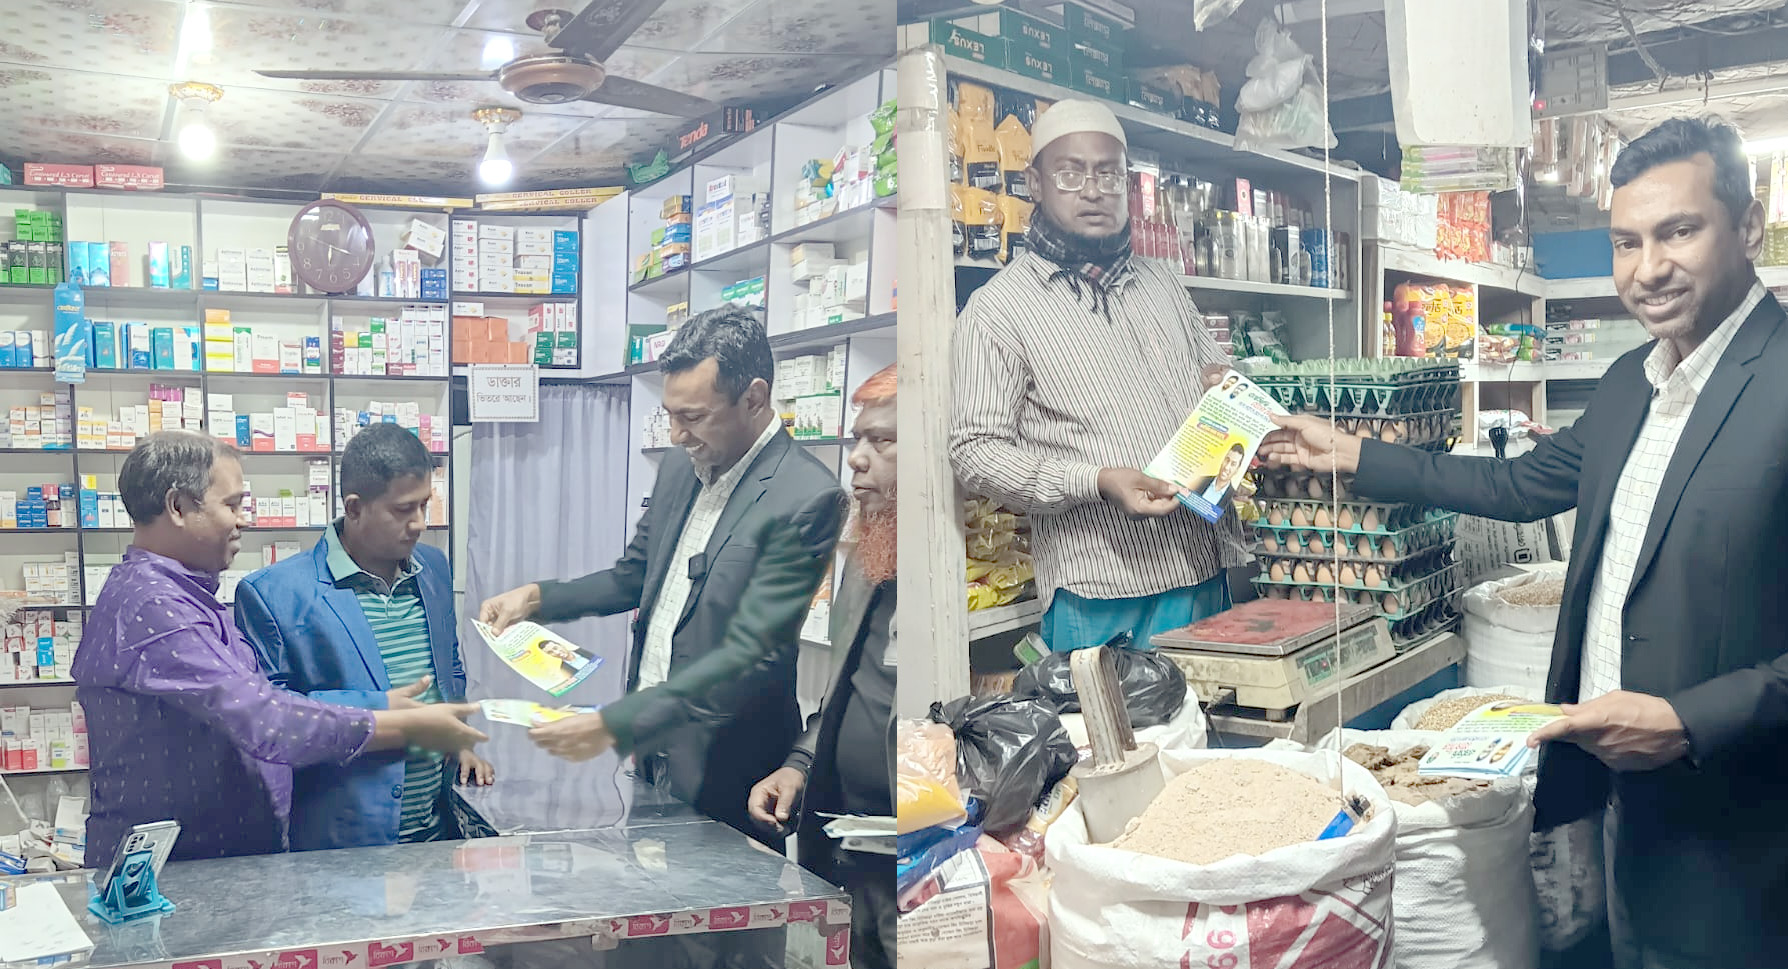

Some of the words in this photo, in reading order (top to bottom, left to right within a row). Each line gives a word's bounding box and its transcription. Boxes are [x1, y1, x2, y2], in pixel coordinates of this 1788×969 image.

[1022, 24, 1051, 43] LEXUS
[953, 34, 985, 54] LEXUS
[1025, 55, 1053, 73] LEXUS
[680, 121, 708, 149] Tenda
[359, 194, 402, 202] CERVICAL
[512, 190, 554, 199] CERVICAL
[559, 187, 592, 196] COLLER
[564, 196, 598, 205] COLLER
[487, 376, 521, 388] ডাক্তার
[476, 391, 501, 403] ভিতরে
[502, 394, 526, 403] আছেন
